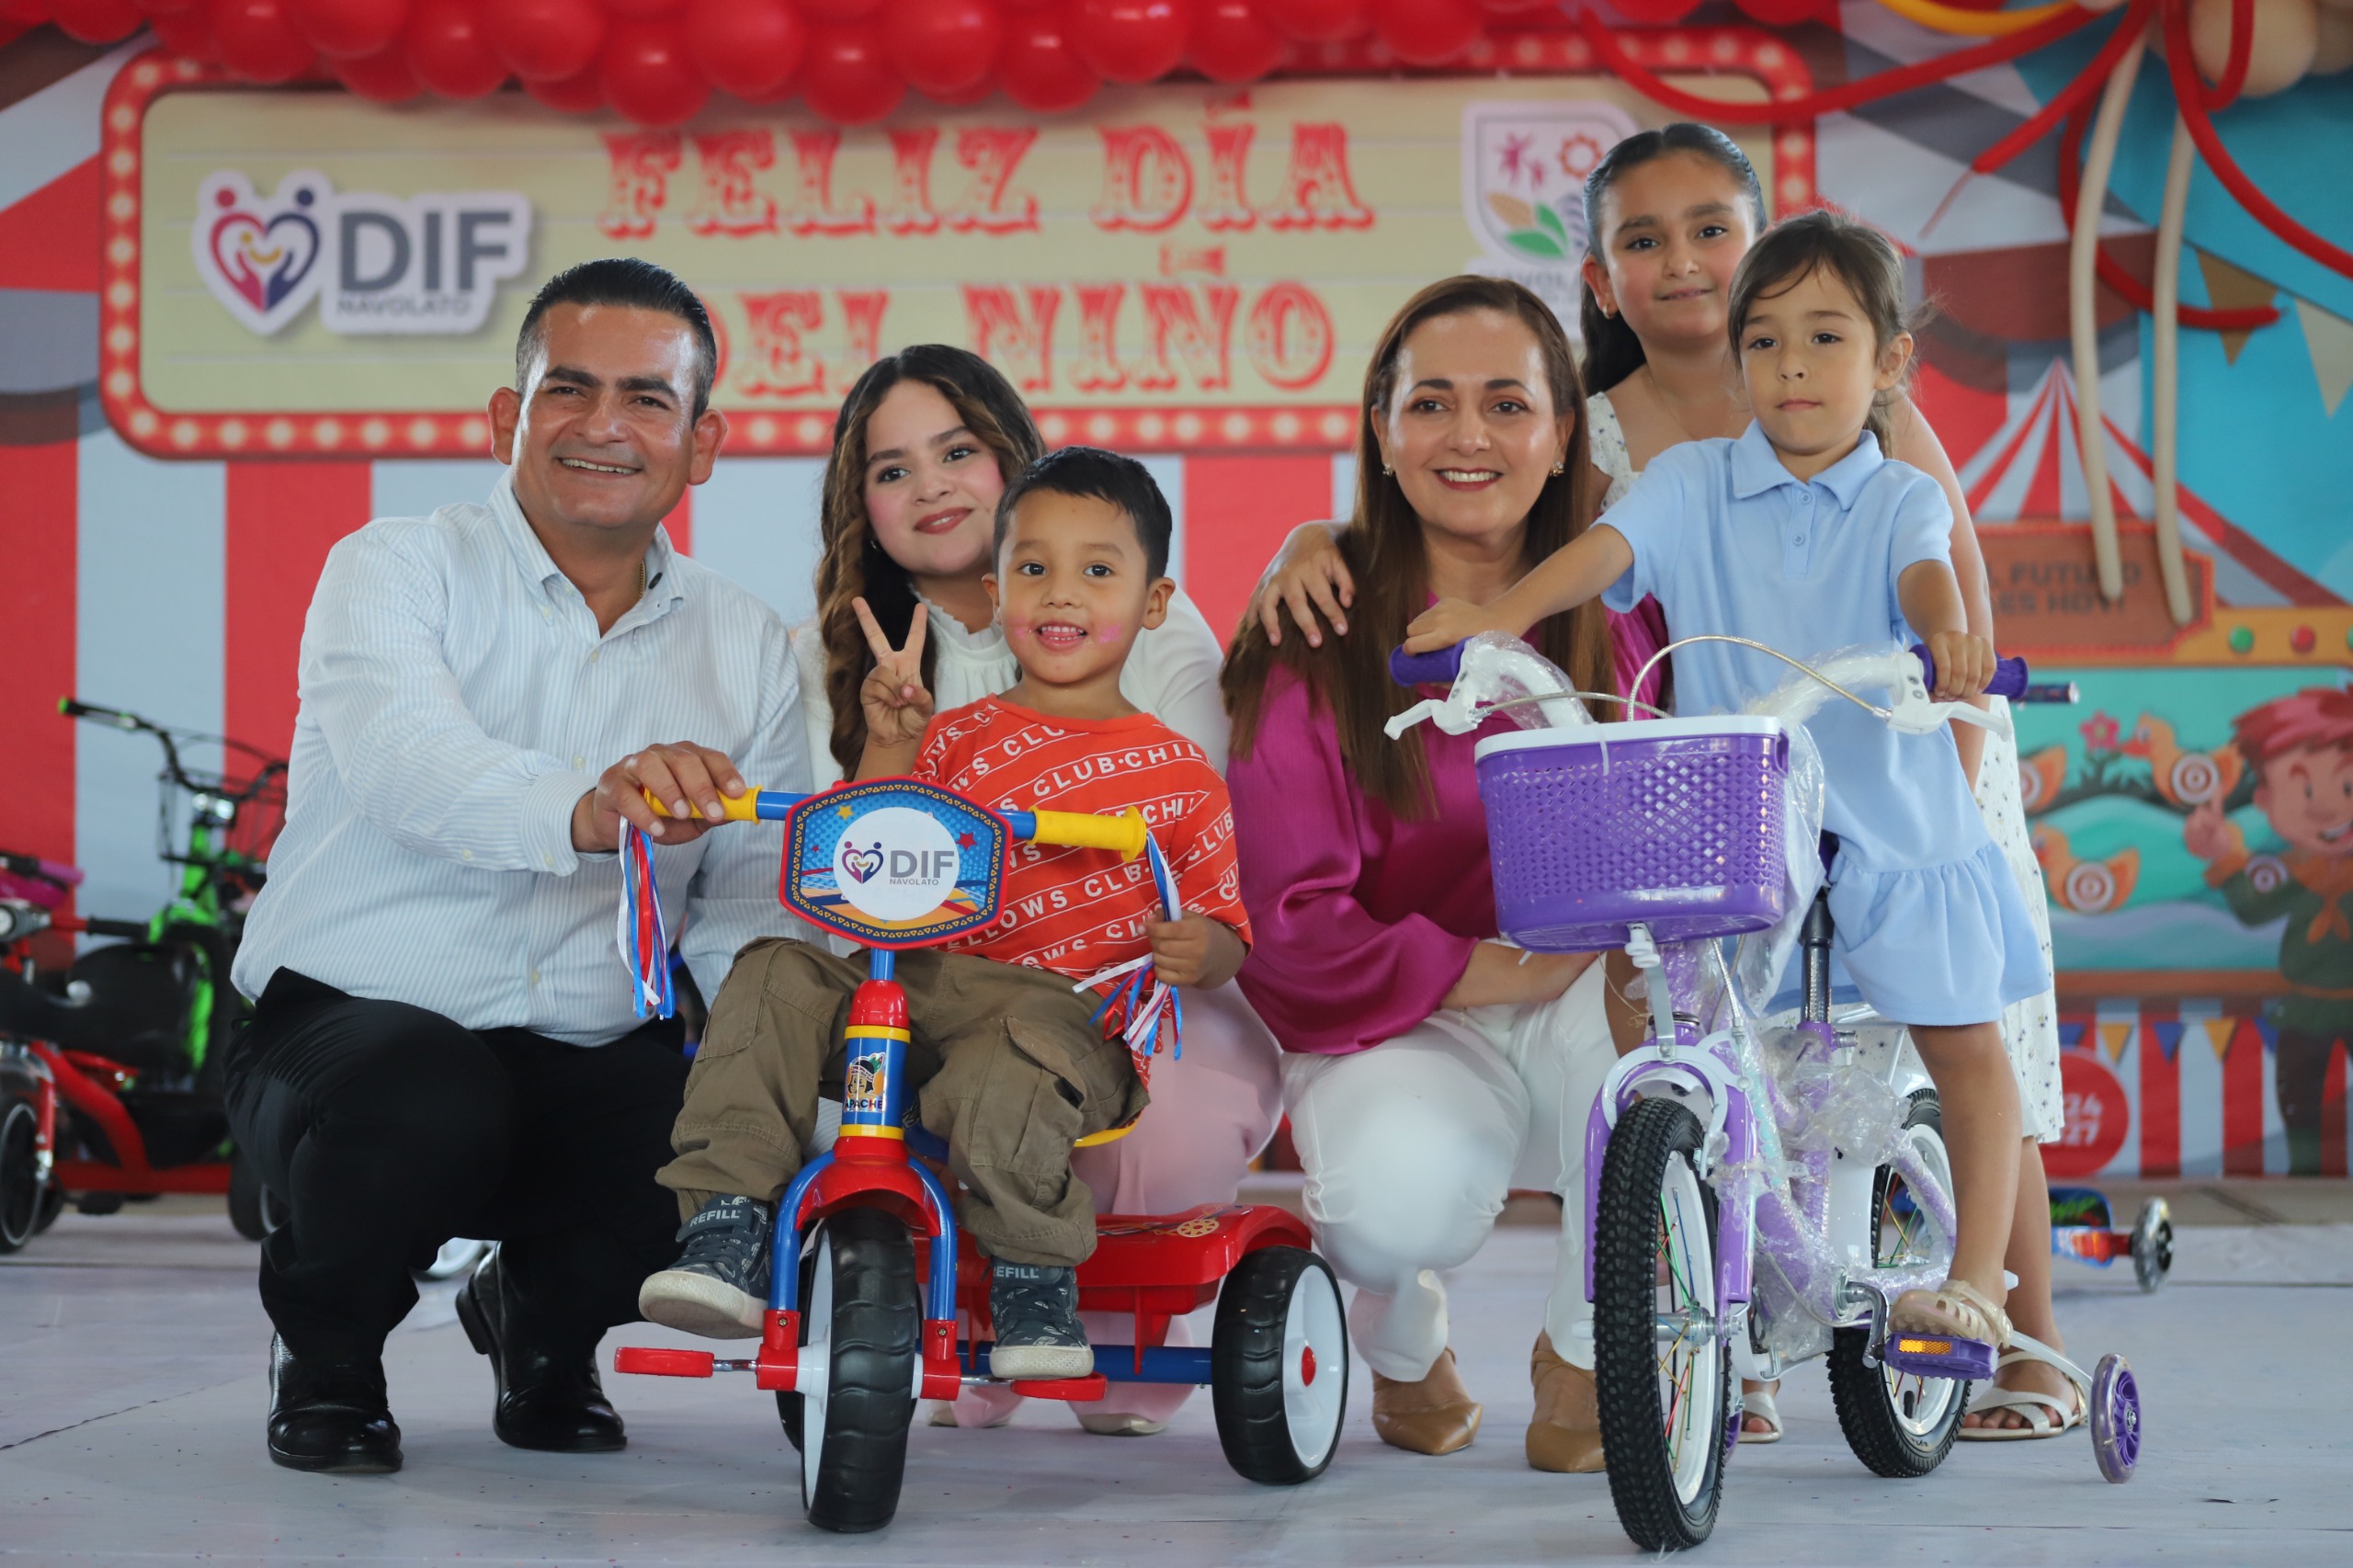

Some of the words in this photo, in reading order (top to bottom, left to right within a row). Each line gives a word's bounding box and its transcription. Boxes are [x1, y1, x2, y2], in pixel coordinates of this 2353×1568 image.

[596, 124, 1041, 239] FELIZ
[1088, 92, 1376, 233] DÍA
[340, 211, 512, 291] DIF
[336, 297, 472, 316] NAVOLATO
[961, 244, 1338, 392] NIÑO
[890, 849, 955, 879] DIF
[890, 878, 939, 886] NAVOLATO
[845, 1098, 883, 1109] APACHE
[689, 1210, 740, 1228] REFILL
